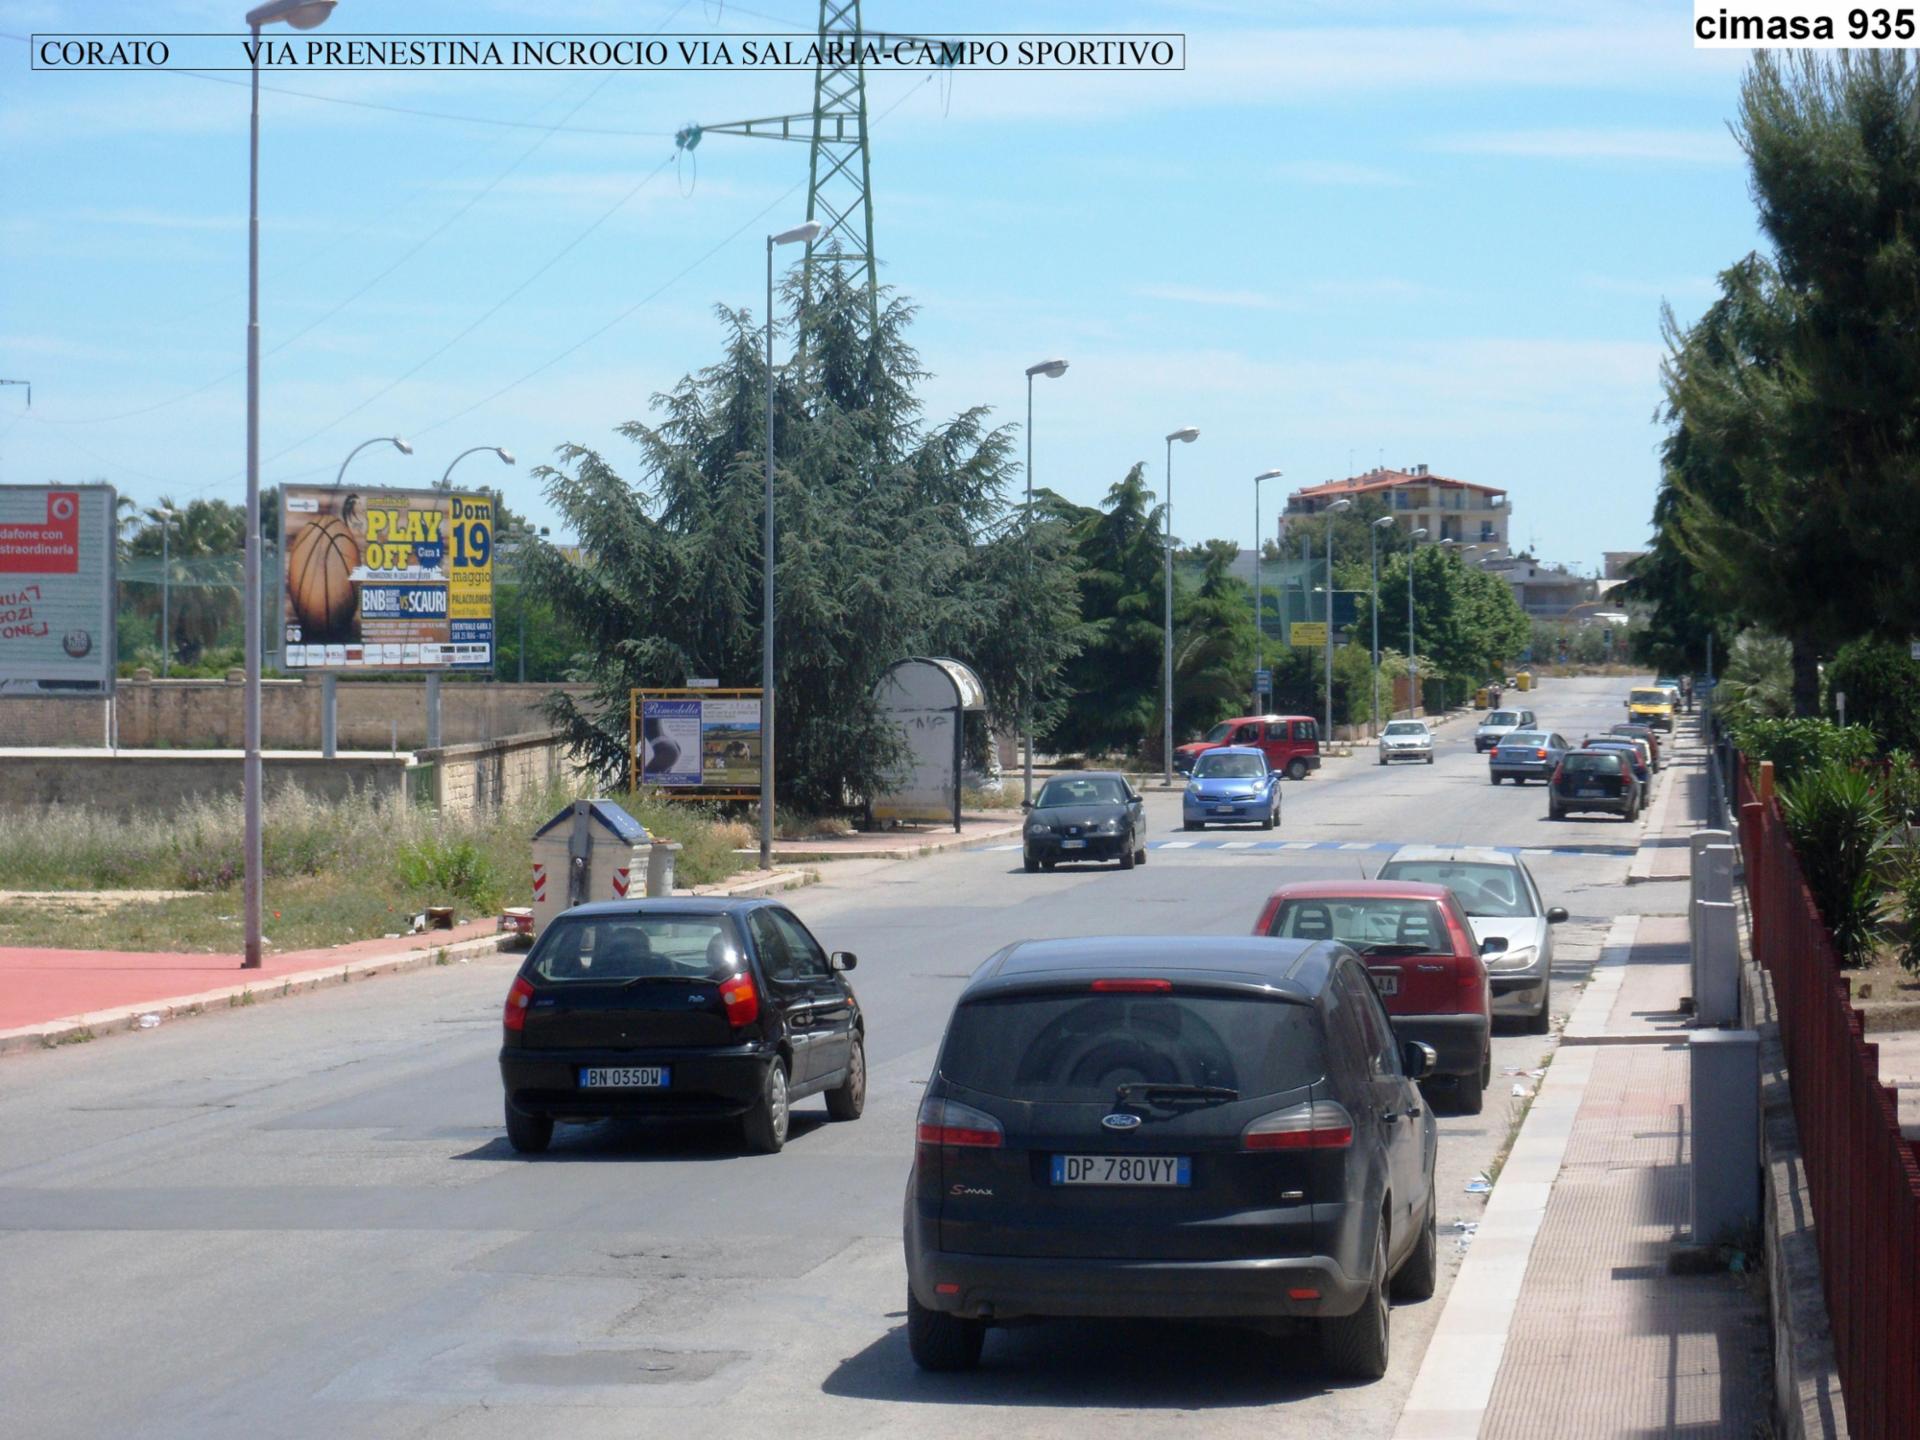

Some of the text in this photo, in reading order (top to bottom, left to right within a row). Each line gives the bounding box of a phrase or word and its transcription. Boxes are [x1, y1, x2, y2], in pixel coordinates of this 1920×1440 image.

[452, 498, 490, 521] Dom
[41, 530, 64, 540] con
[366, 509, 443, 542] PLAY
[366, 543, 413, 571] OFF
[453, 522, 490, 568] 19
[452, 571, 491, 587] maggio
[361, 589, 386, 611] BNB
[408, 590, 447, 613] SCAURI
[589, 1069, 659, 1086] BN 035DW
[1067, 1158, 1095, 1181] DP
[1104, 1158, 1175, 1182] 780VY
